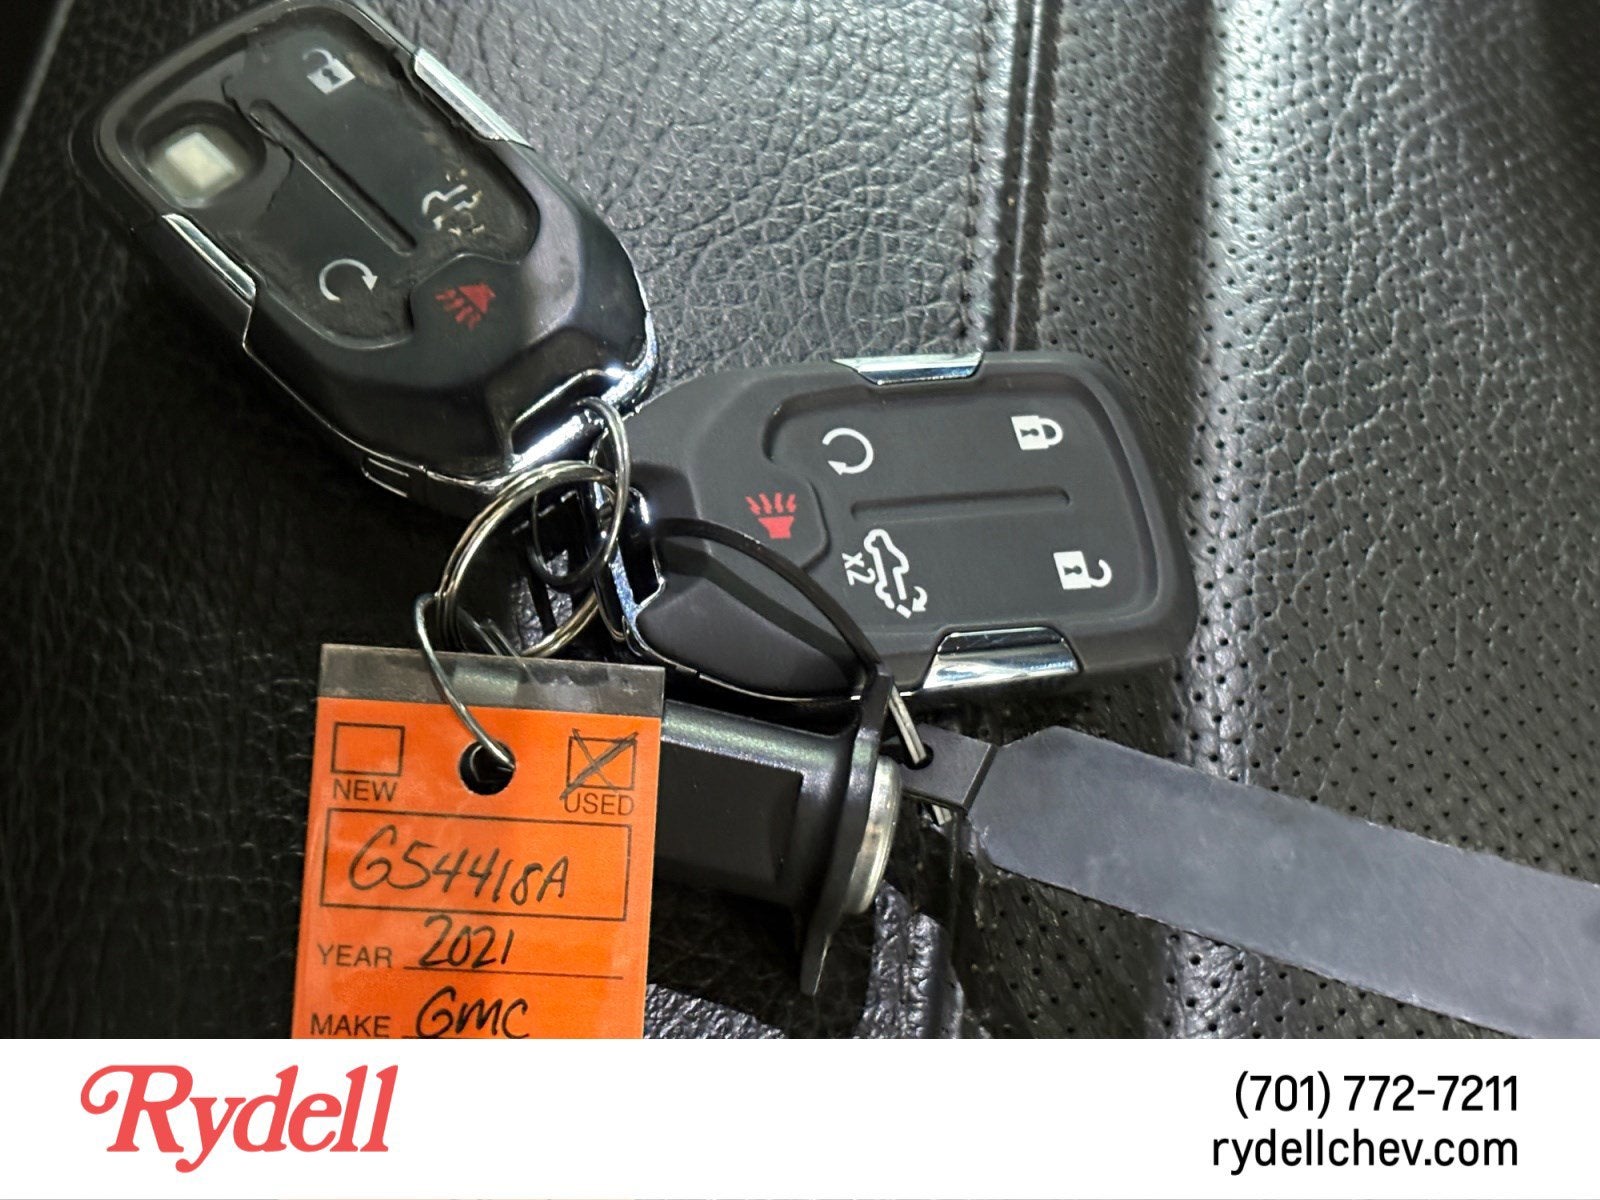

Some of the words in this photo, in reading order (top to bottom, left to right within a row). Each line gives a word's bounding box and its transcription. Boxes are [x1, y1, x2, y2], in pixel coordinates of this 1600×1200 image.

[332, 779, 398, 802] NEW
[562, 791, 635, 817] USED
[317, 944, 393, 969] YEAR
[418, 914, 515, 969] 2021
[310, 1013, 391, 1038] MAKE
